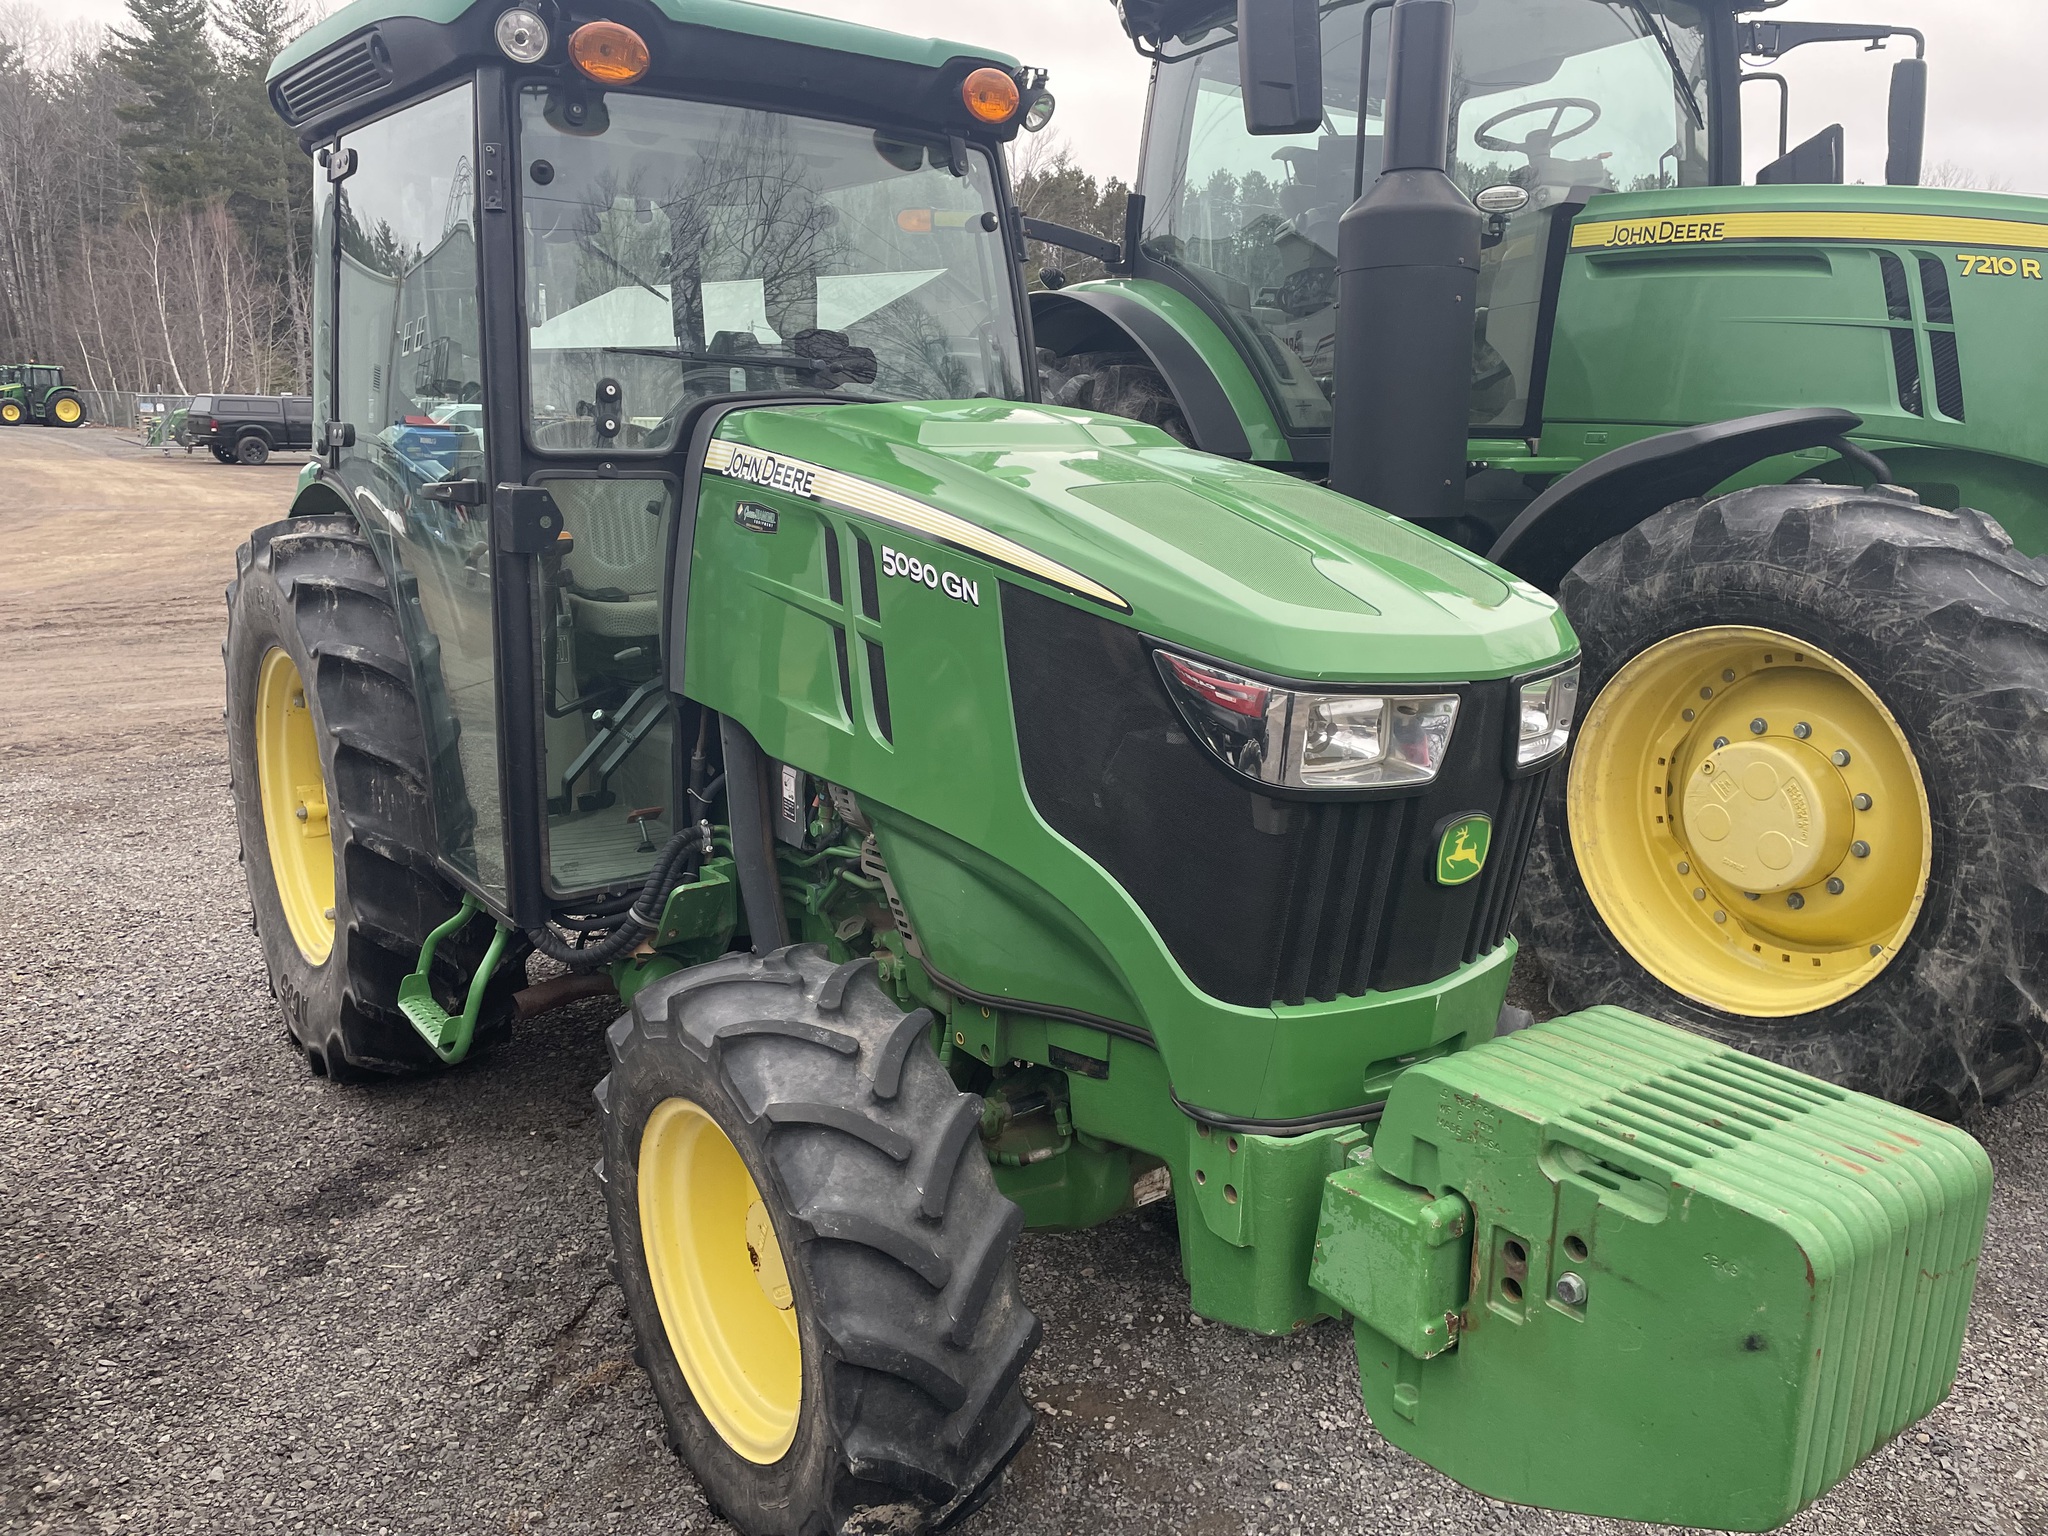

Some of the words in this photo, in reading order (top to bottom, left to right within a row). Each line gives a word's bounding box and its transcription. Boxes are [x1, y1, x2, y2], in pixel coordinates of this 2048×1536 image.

[1605, 224, 1657, 245] JOHN
[1658, 220, 1725, 242] DEERE
[1956, 254, 2018, 277] 7210
[2020, 258, 2043, 280] R
[723, 447, 763, 482] JOHN
[760, 455, 816, 497] DEERE
[881, 544, 938, 590] 5090
[941, 570, 979, 608] GN
